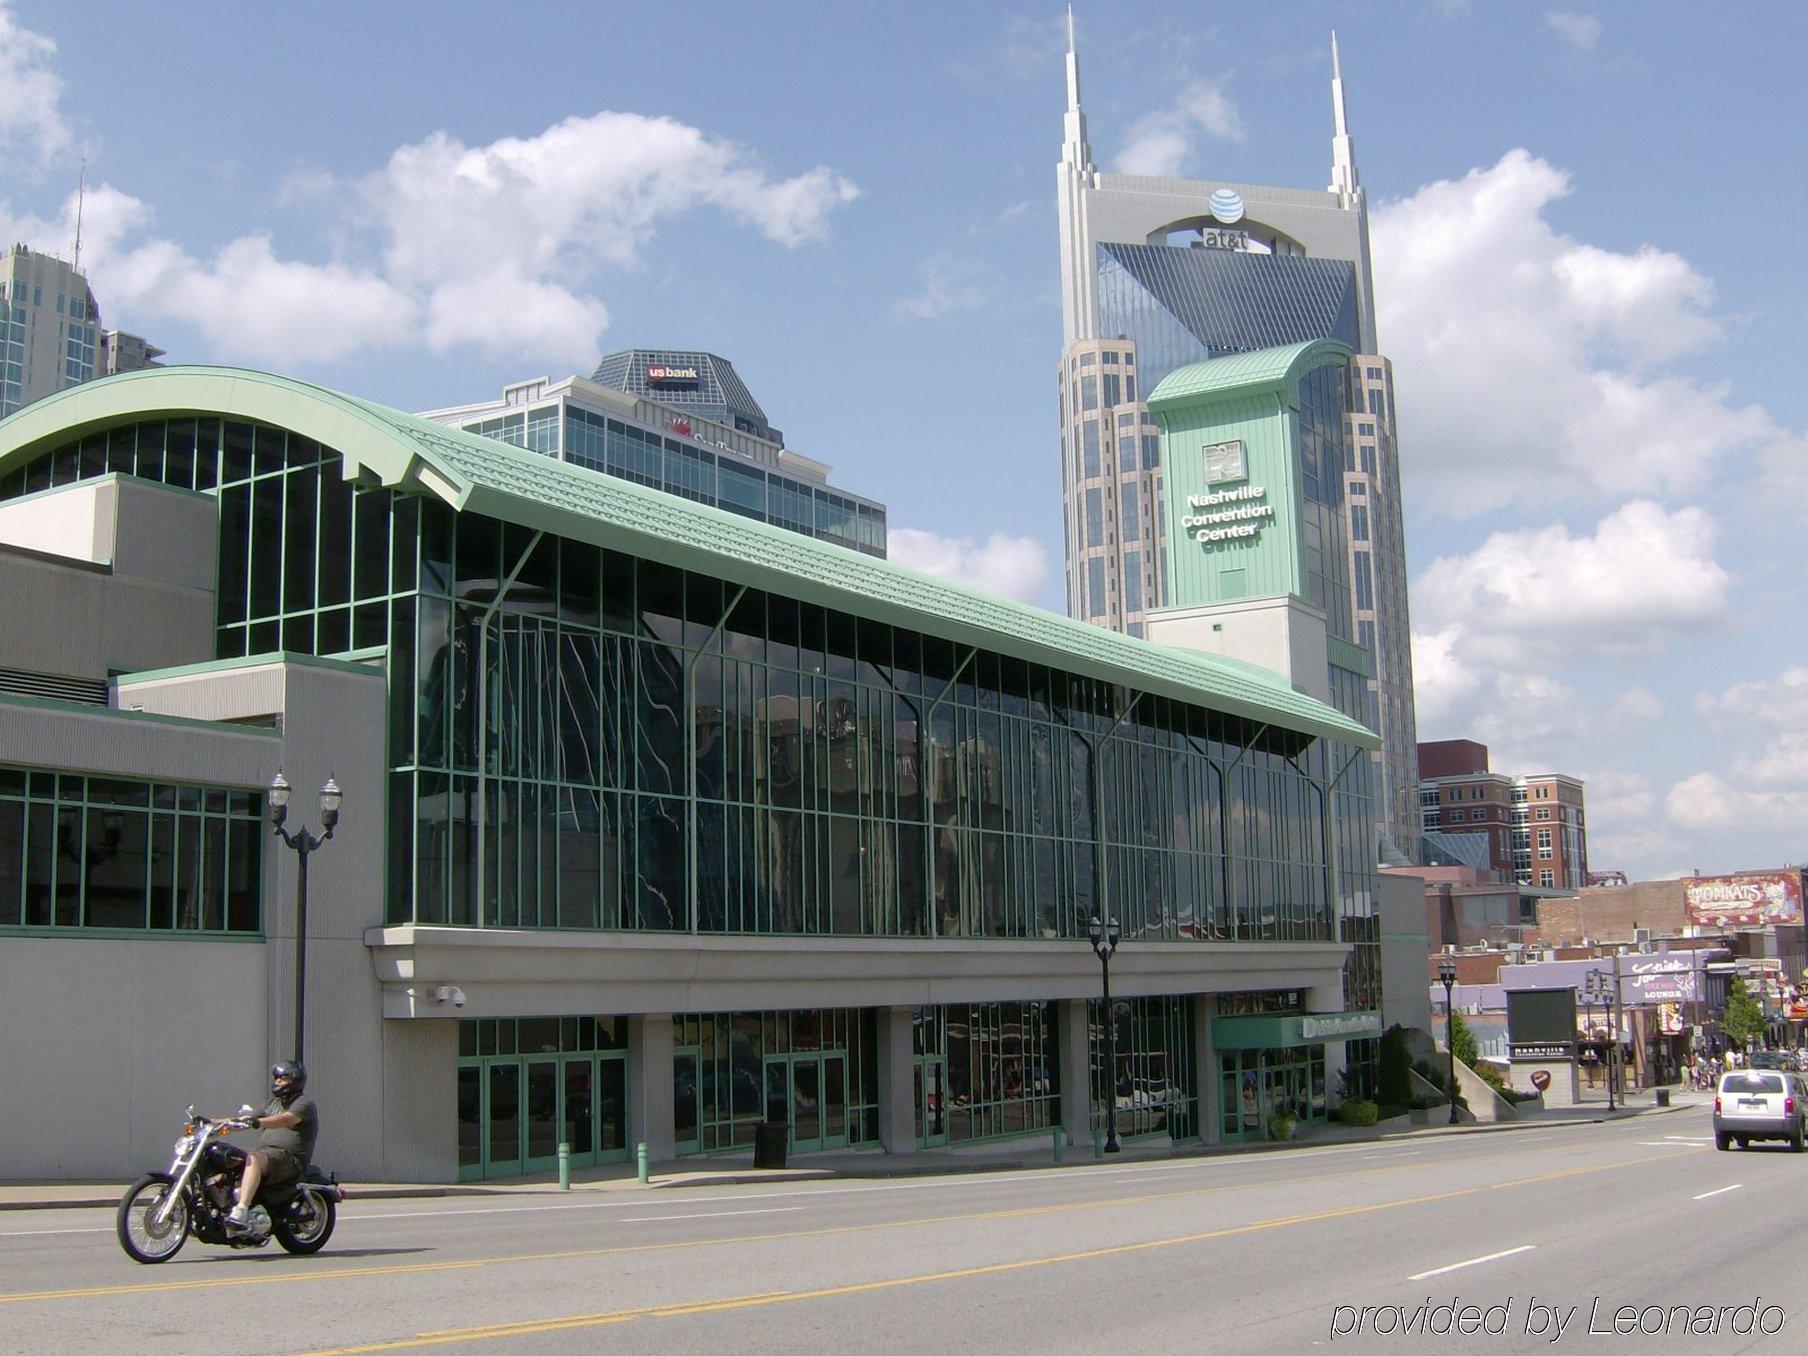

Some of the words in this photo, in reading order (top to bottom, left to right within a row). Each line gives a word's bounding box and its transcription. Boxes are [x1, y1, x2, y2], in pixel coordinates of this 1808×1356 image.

[1206, 230, 1248, 250] at&t
[1187, 485, 1265, 507] Nashville
[1181, 505, 1272, 528] Convention
[1196, 522, 1257, 542] Center
